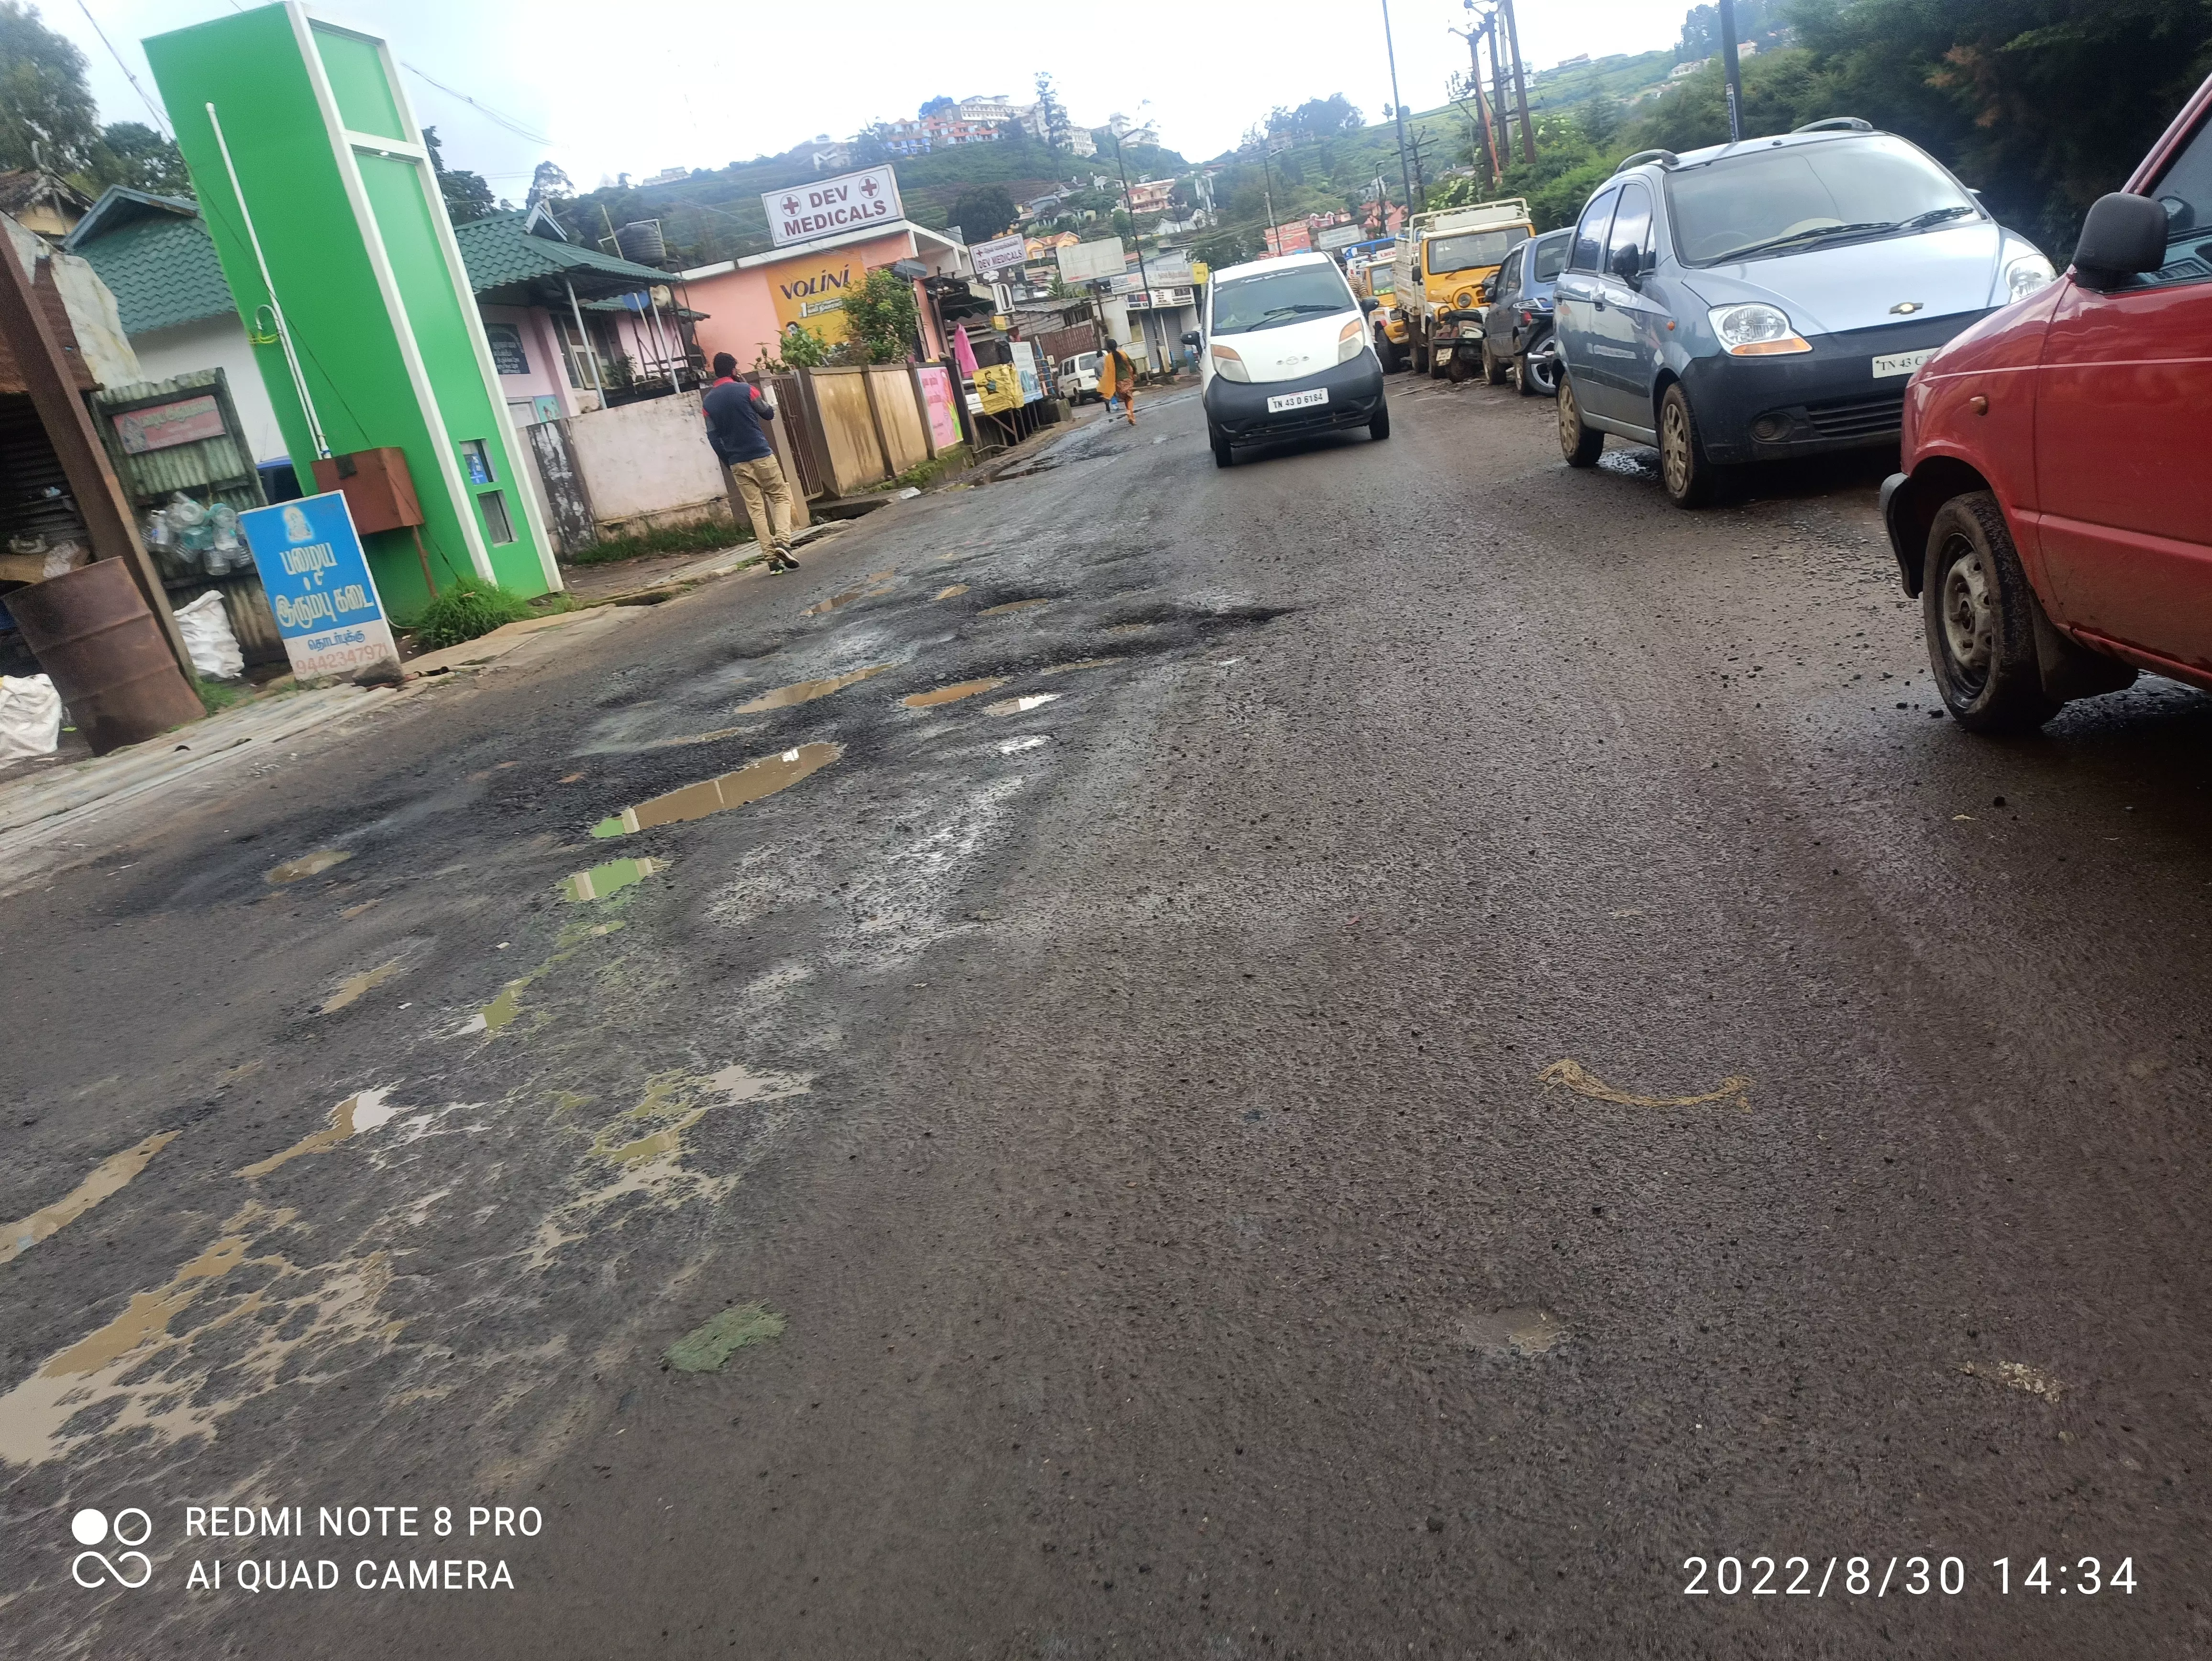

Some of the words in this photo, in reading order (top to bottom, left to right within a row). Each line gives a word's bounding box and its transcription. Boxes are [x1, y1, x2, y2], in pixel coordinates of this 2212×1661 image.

[808, 185, 848, 208] DEV
[783, 199, 887, 236] MEDICALS
[1879, 360, 1896, 371] TN
[1272, 400, 1283, 409] TN
[1285, 398, 1294, 406] 43
[1296, 397, 1302, 405] D
[333, 585, 375, 613] கடை
